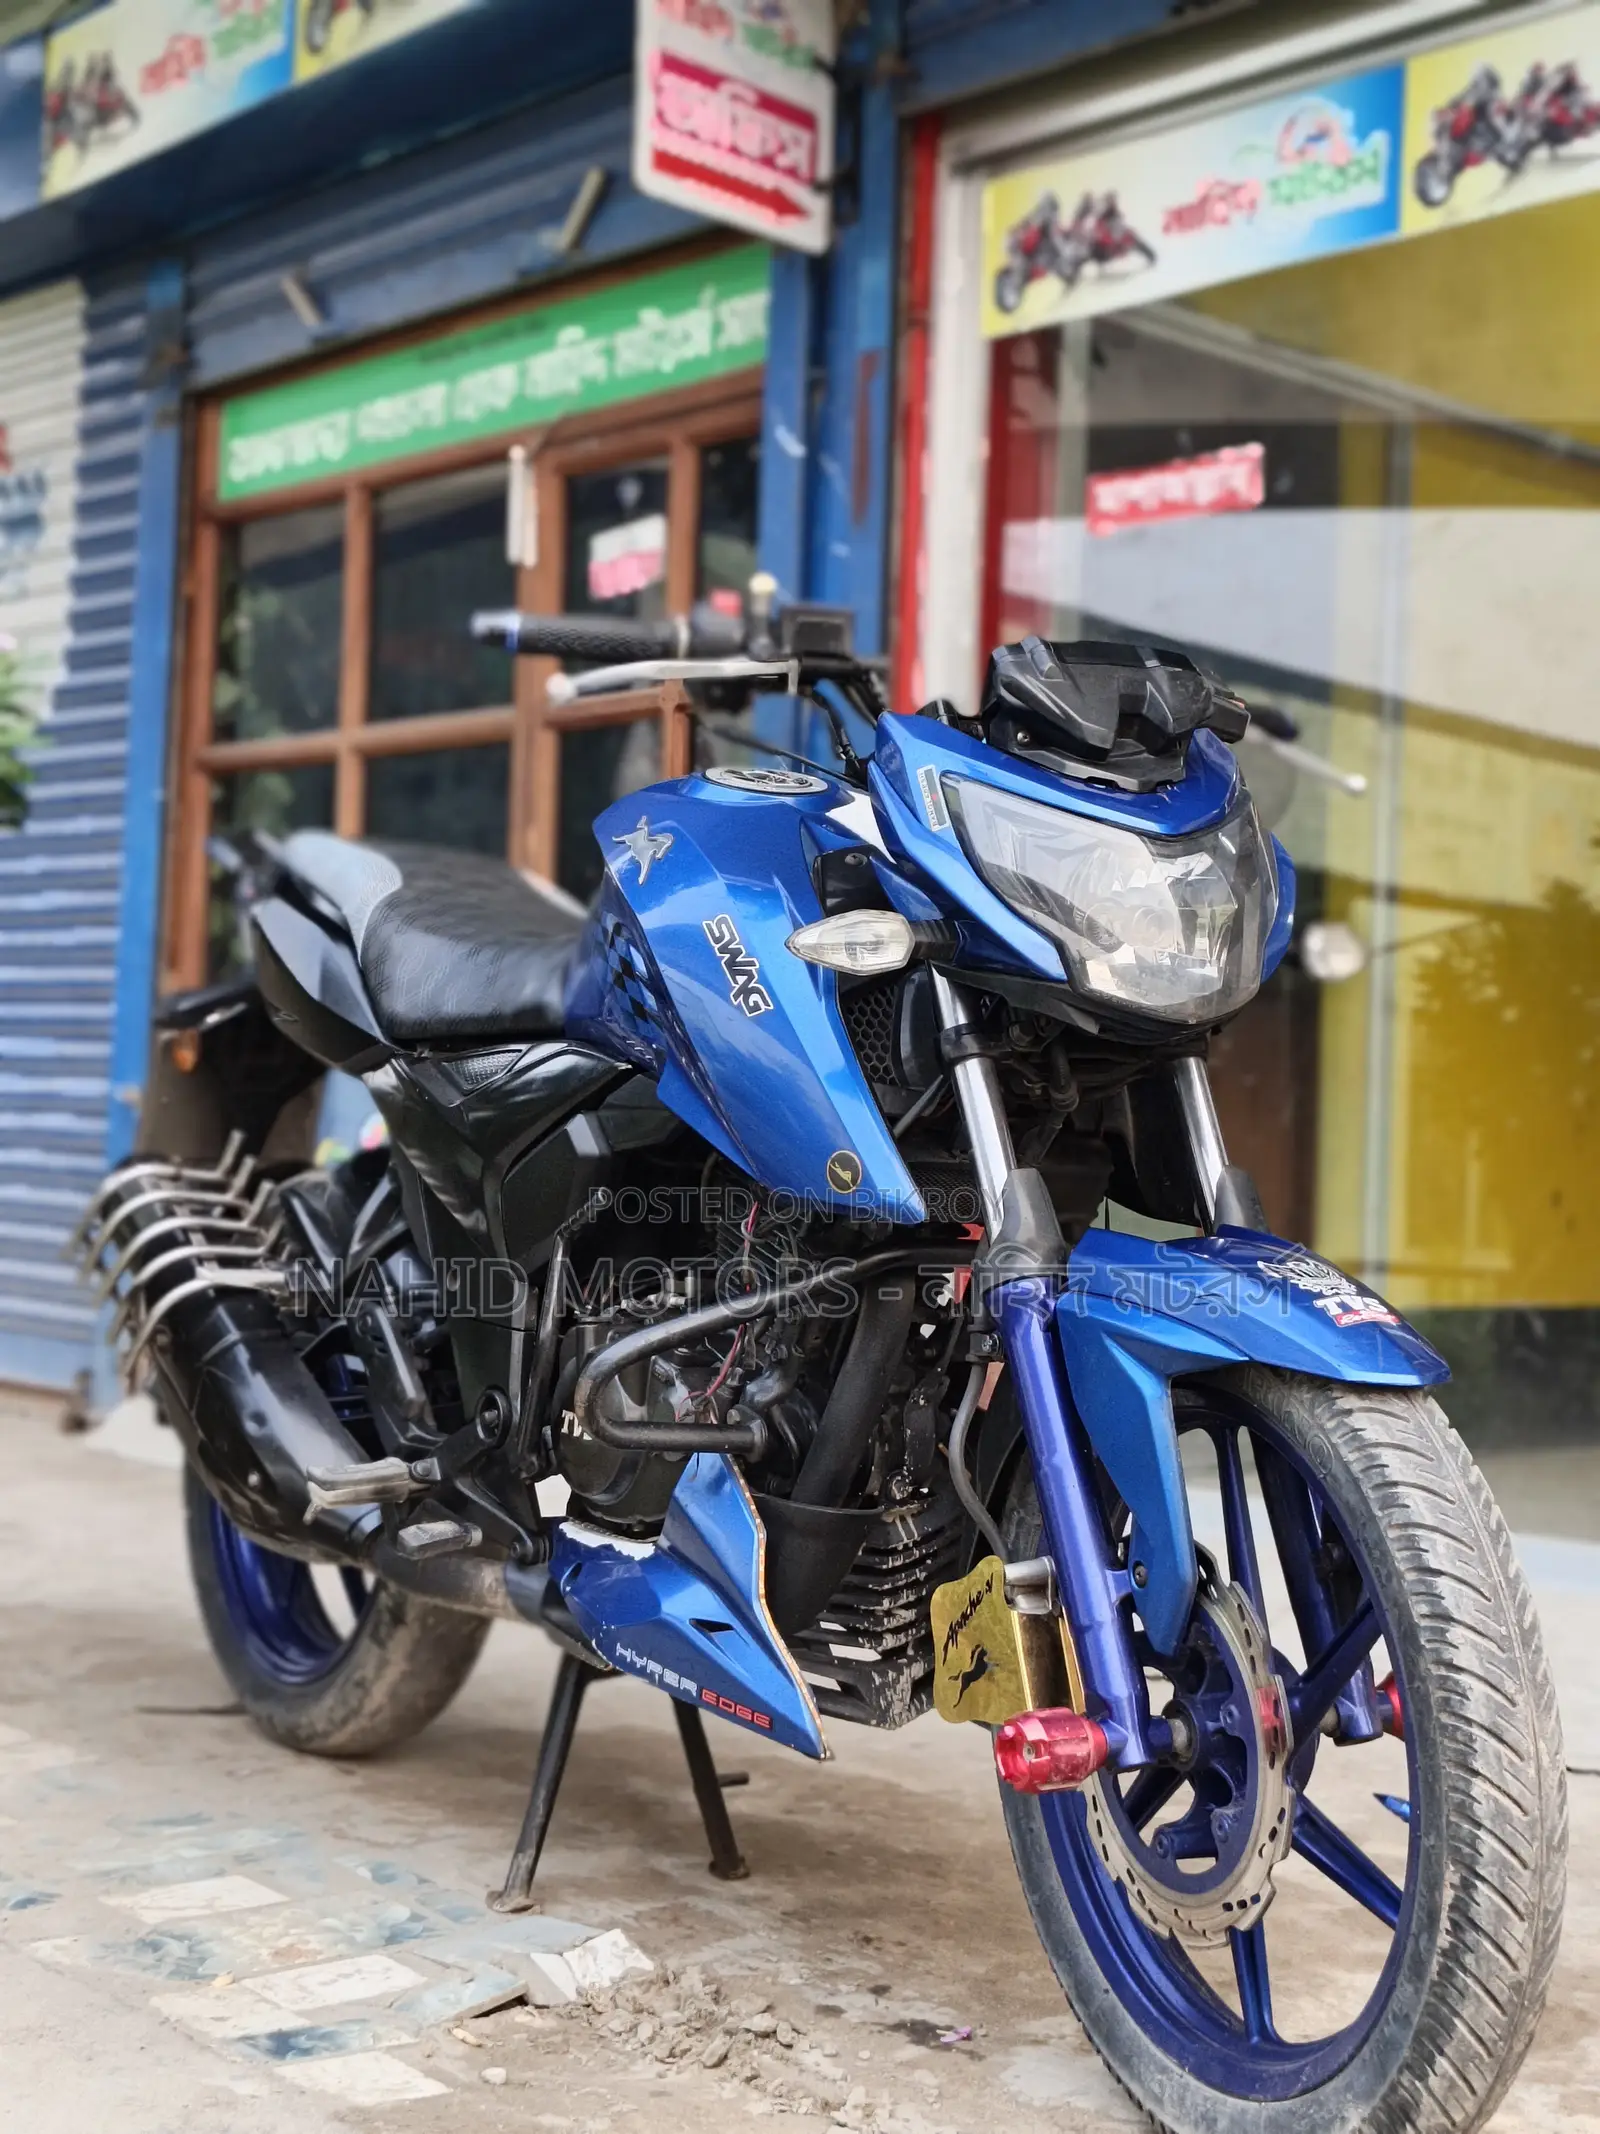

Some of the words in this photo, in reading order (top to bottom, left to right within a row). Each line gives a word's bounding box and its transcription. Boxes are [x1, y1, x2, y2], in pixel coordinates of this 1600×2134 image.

[702, 914, 774, 1017] SWAG
[1313, 1295, 1389, 1316] TVS
[561, 1409, 593, 1441] TV
[615, 1642, 698, 1697] HYPER
[701, 1688, 772, 1730] EDGE
